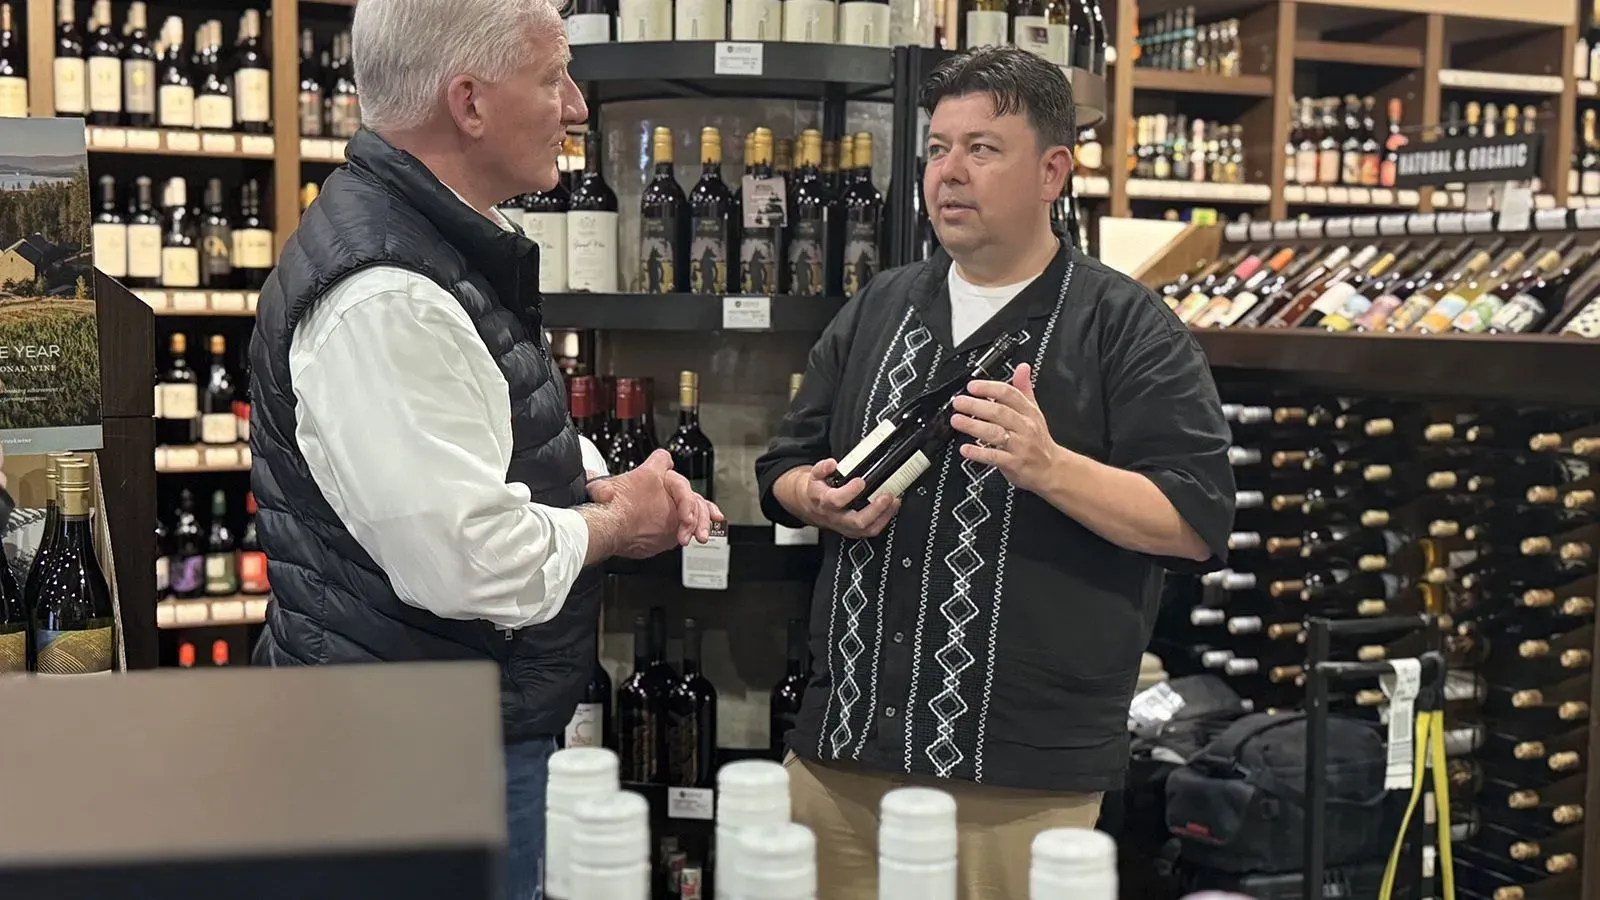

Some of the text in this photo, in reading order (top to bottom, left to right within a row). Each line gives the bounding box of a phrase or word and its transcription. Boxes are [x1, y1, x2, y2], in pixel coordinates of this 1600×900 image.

[1398, 143, 1528, 175] NATURAL & ORGANIC
[14, 345, 60, 358] YEAR
[31, 364, 57, 372] WINE
